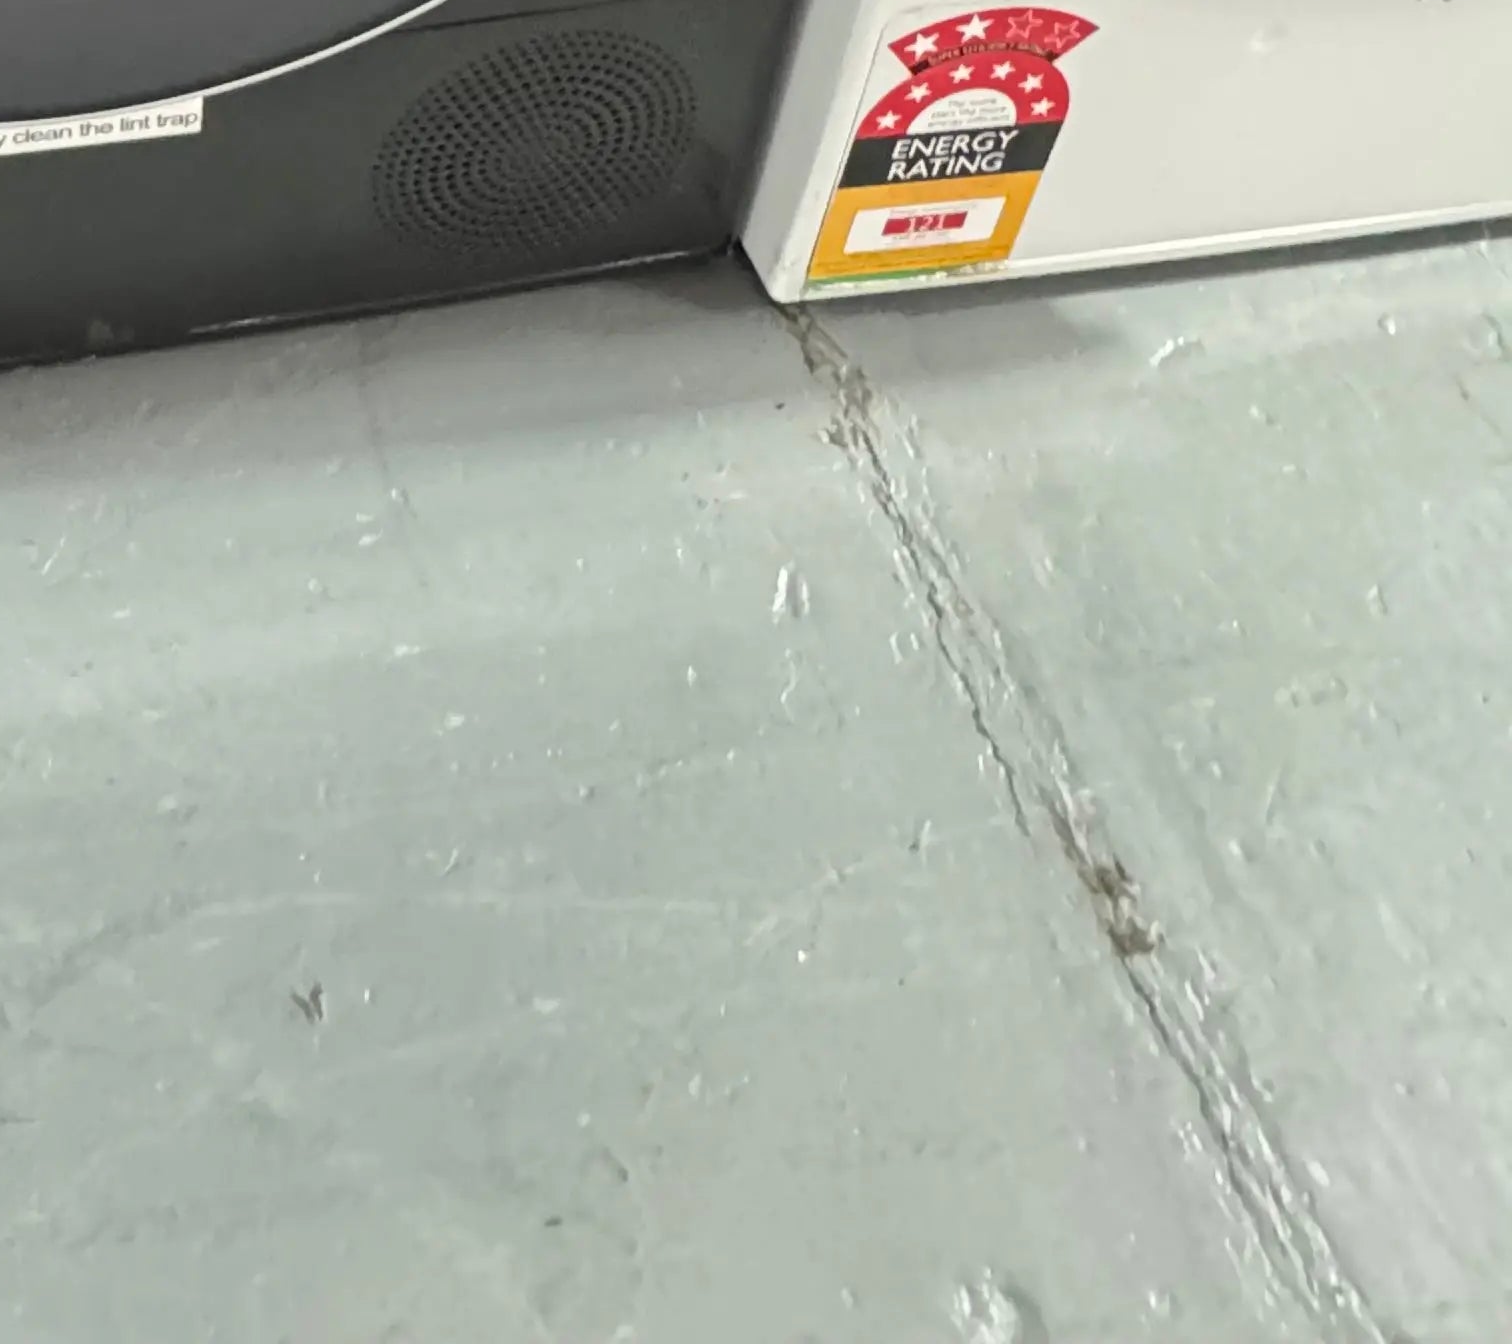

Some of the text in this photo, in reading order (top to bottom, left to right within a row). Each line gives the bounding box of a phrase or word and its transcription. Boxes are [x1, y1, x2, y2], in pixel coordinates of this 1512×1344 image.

[12, 126, 73, 145] clean
[79, 121, 114, 137] the
[119, 115, 151, 132] lint
[156, 112, 199, 129] trap
[891, 129, 1019, 161] ENERGY
[887, 151, 1006, 181] RATING
